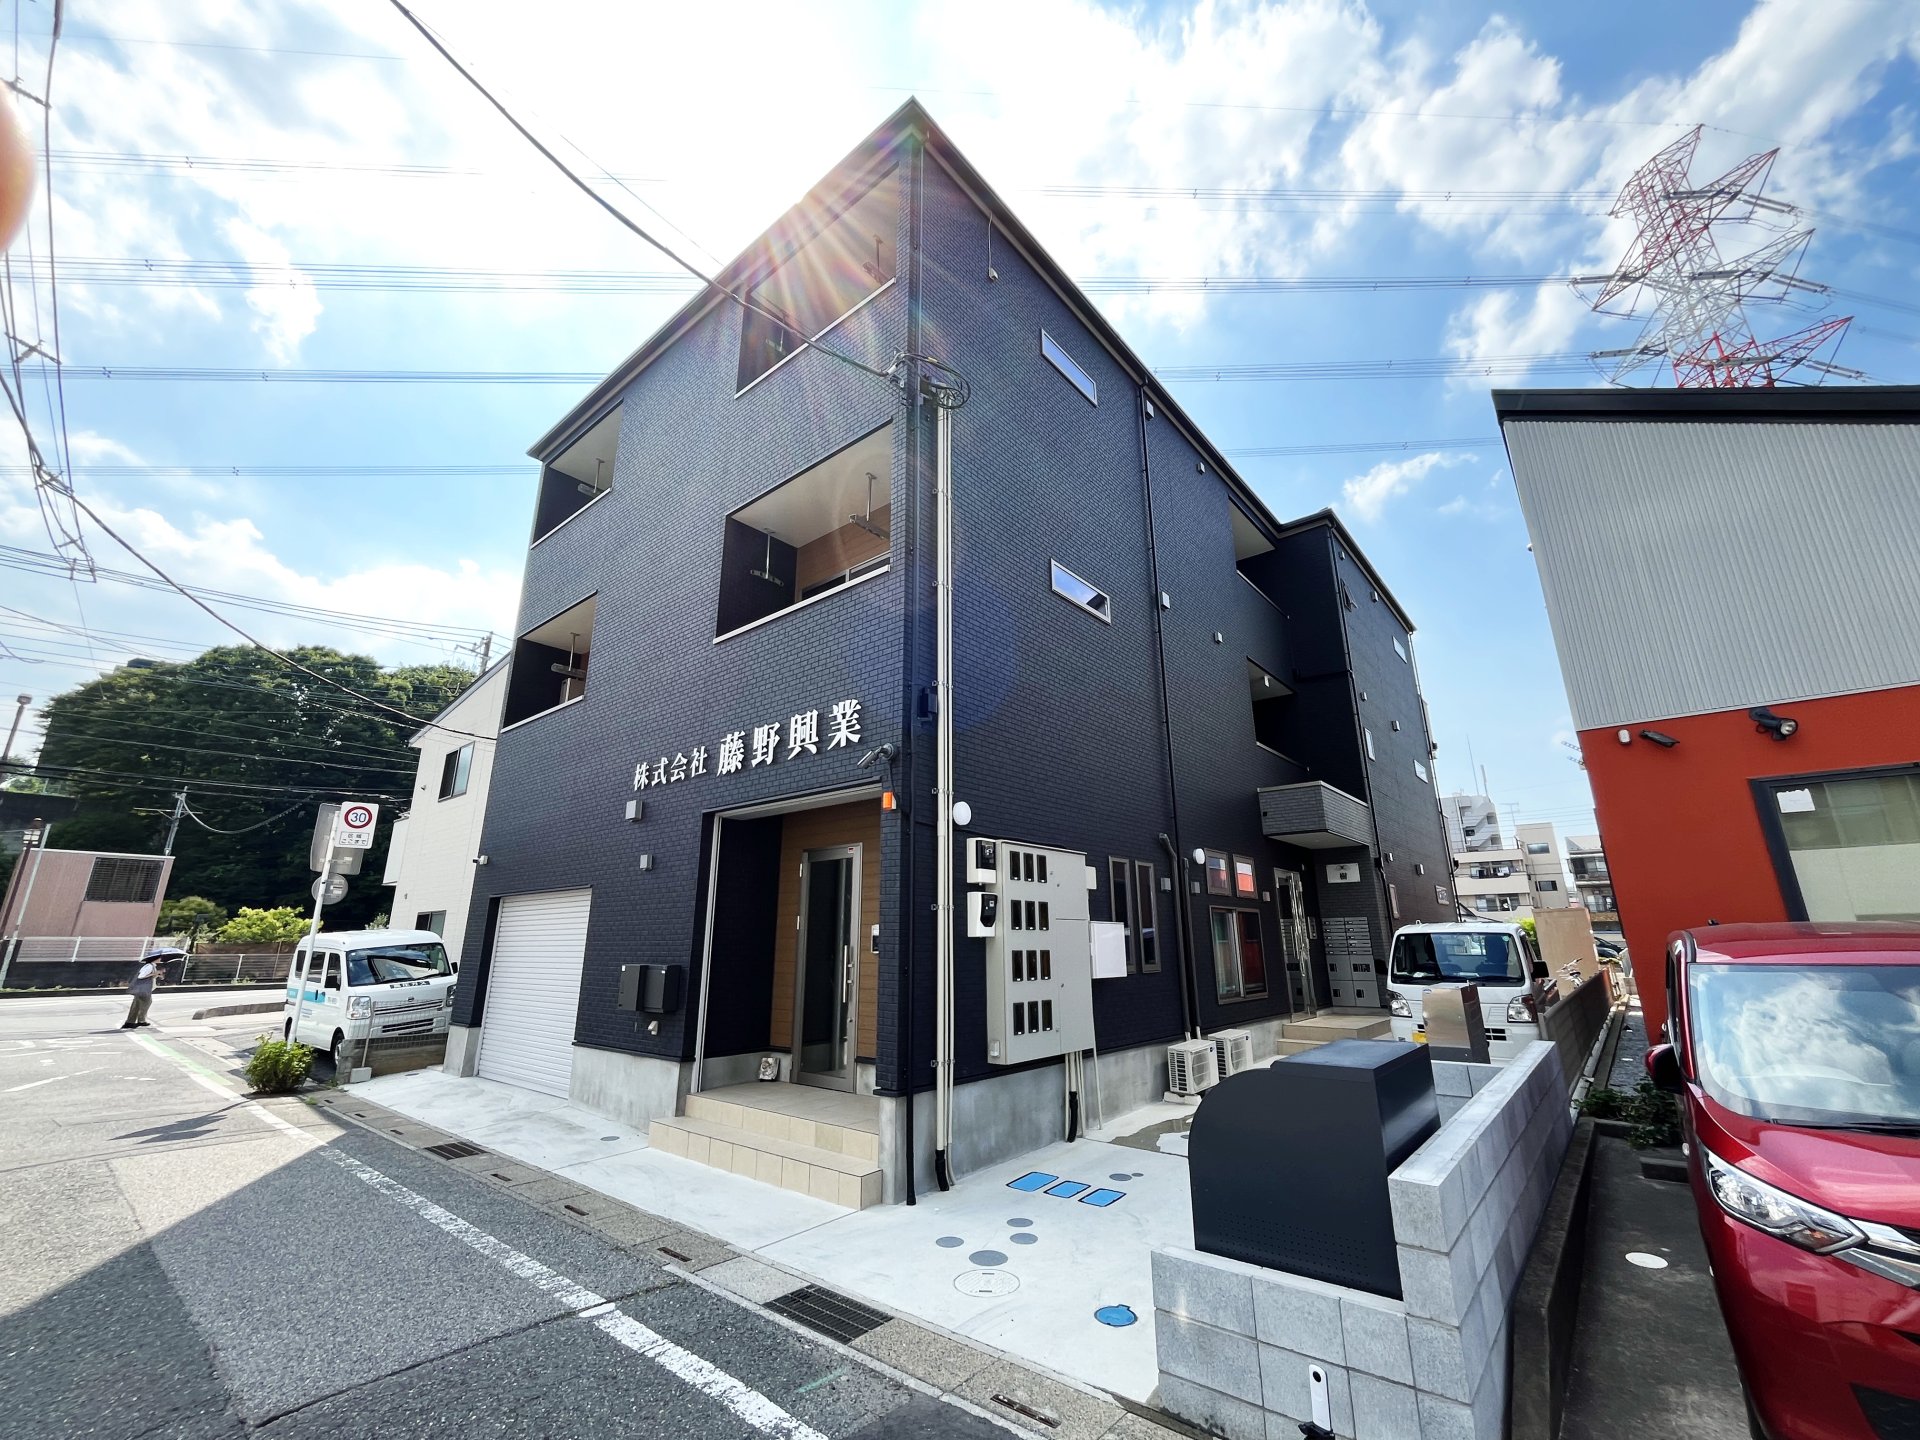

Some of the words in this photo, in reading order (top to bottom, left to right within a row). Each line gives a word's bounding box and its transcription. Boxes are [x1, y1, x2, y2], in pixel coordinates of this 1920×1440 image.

[633, 699, 862, 791] 株式会社藤野興業
[350, 812, 367, 823] 30
